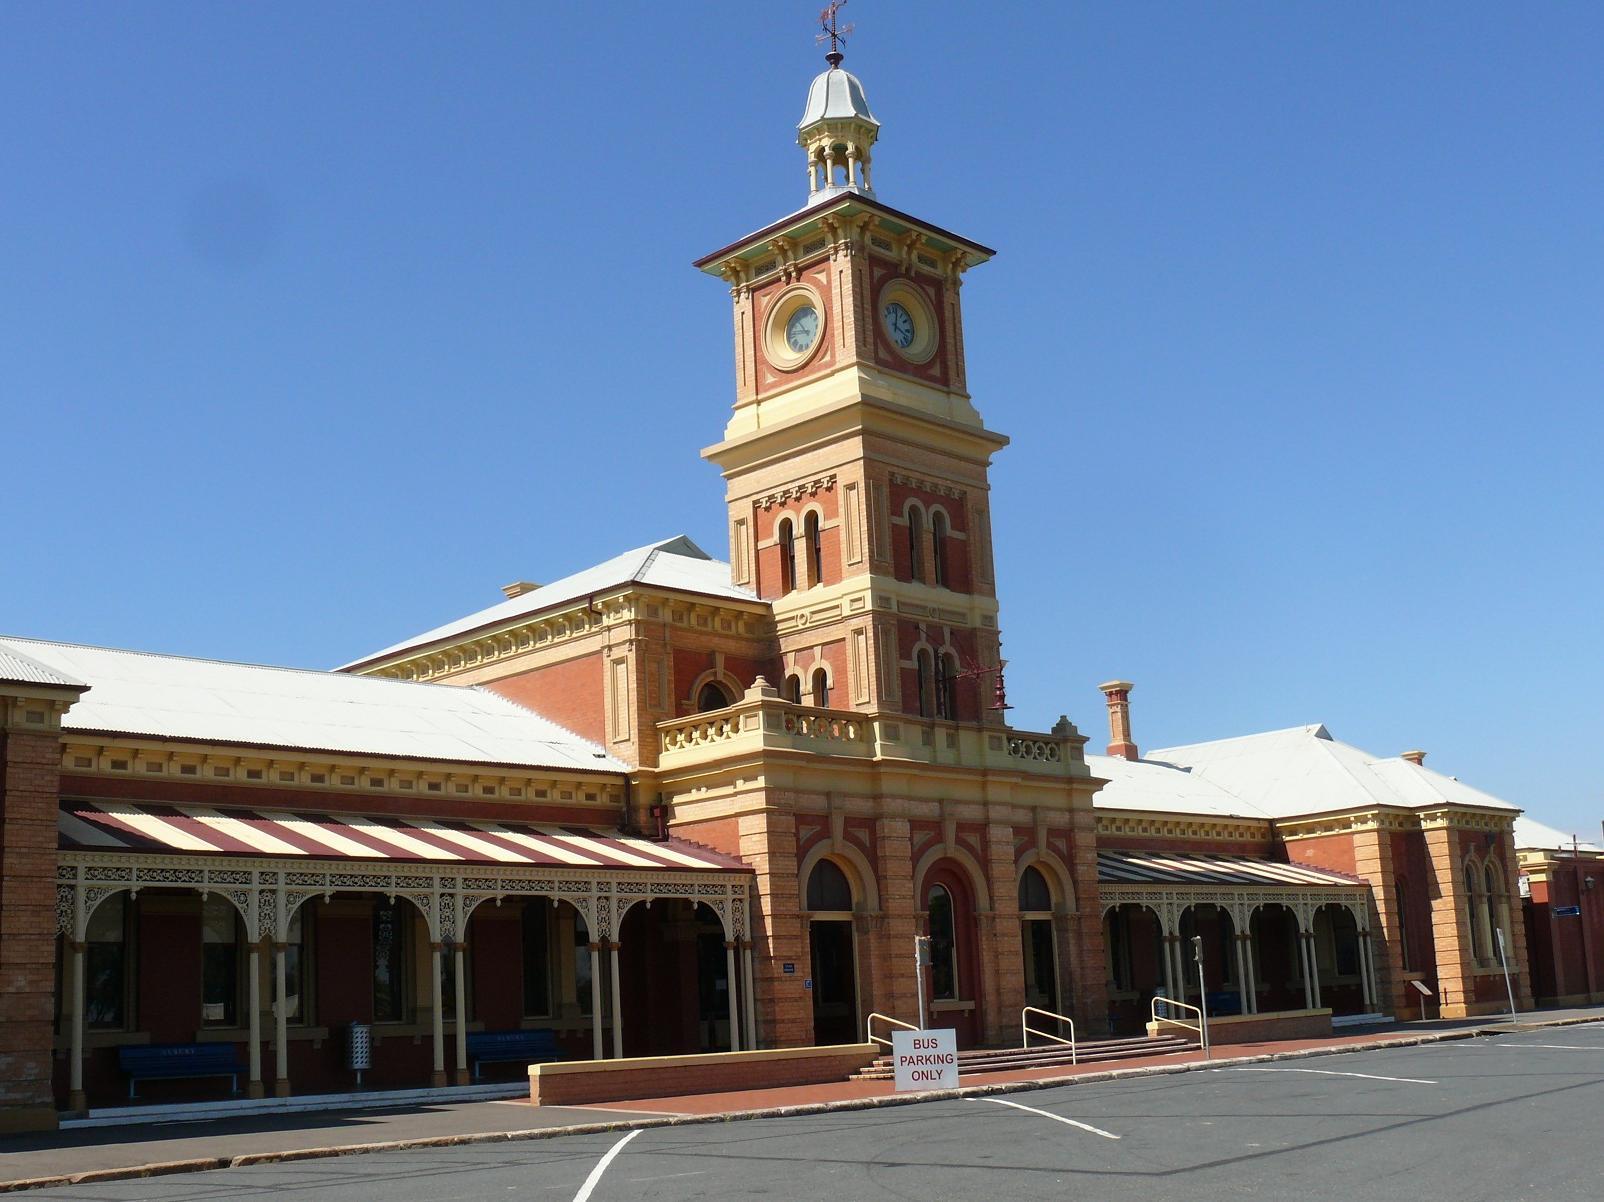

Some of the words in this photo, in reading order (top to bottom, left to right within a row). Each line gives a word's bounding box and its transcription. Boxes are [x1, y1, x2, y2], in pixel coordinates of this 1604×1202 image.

[913, 1038, 938, 1050] BUS
[900, 1053, 954, 1067] PARKING
[911, 1069, 943, 1081] ONLY
